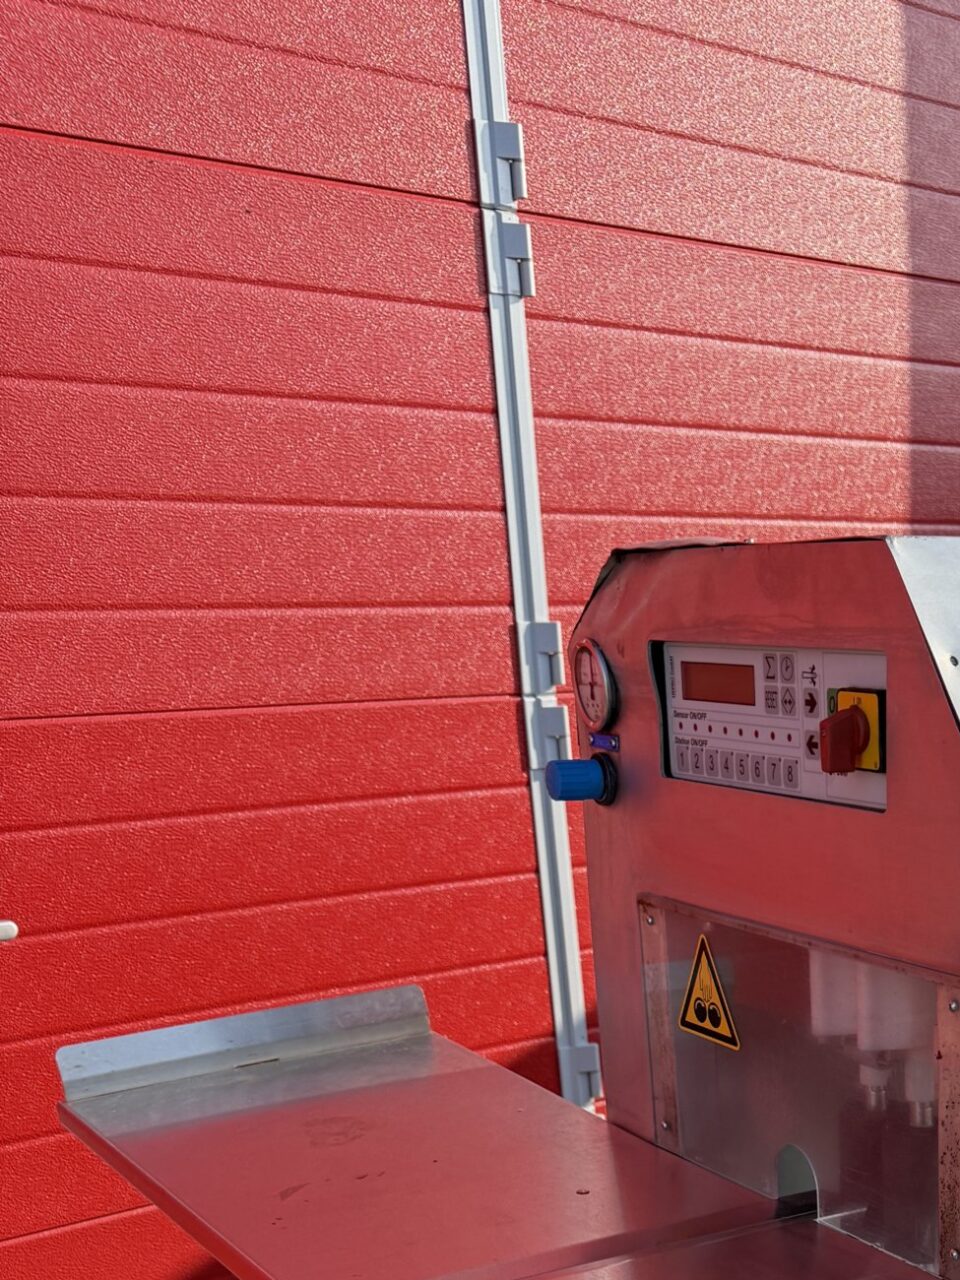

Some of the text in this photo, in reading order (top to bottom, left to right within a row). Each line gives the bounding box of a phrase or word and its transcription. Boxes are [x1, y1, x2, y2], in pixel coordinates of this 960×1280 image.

[689, 711, 707, 721] ON/OFF
[690, 738, 708, 747] ON/OFF
[680, 753, 793, 783] 1 2 3 4 5 6 7 8
